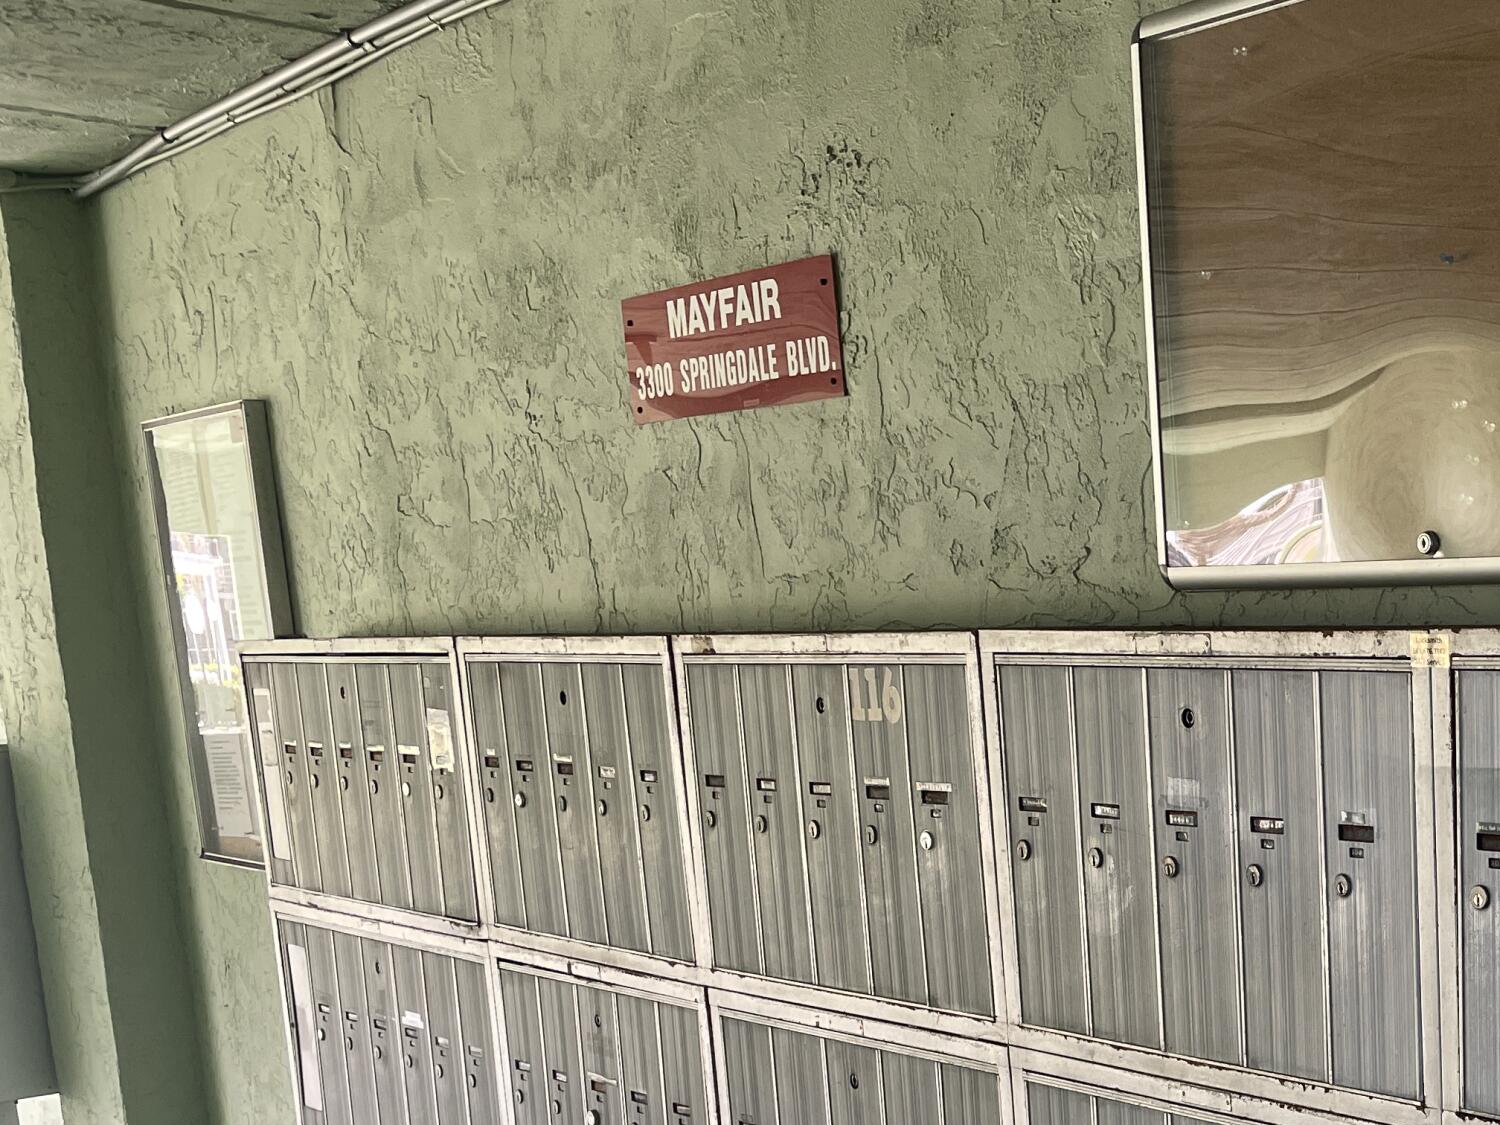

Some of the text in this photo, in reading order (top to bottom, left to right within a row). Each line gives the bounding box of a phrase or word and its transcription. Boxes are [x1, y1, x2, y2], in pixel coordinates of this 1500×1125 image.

[666, 278, 781, 338] MAYFAIR
[636, 335, 837, 400] 3300 SPRINGDALE BLVD.
[848, 667, 902, 725] 116
